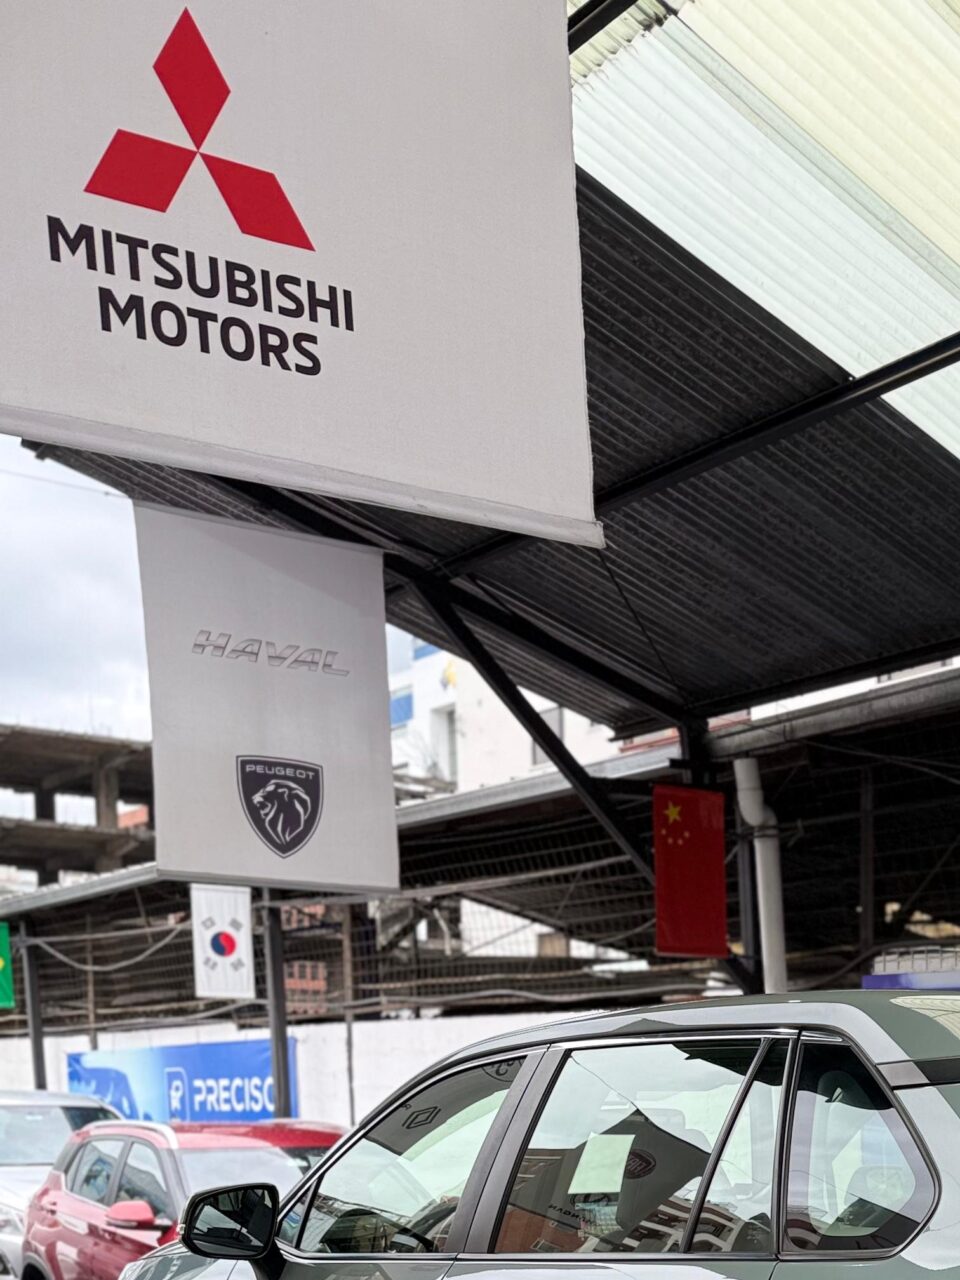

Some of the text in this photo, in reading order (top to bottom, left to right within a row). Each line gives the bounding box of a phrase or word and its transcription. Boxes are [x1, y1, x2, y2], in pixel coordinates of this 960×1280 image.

[46, 214, 354, 331] MITSUBISHI
[97, 285, 321, 376] MOTORS
[191, 629, 350, 677] HAVAL
[245, 764, 316, 781] PEUGEOT
